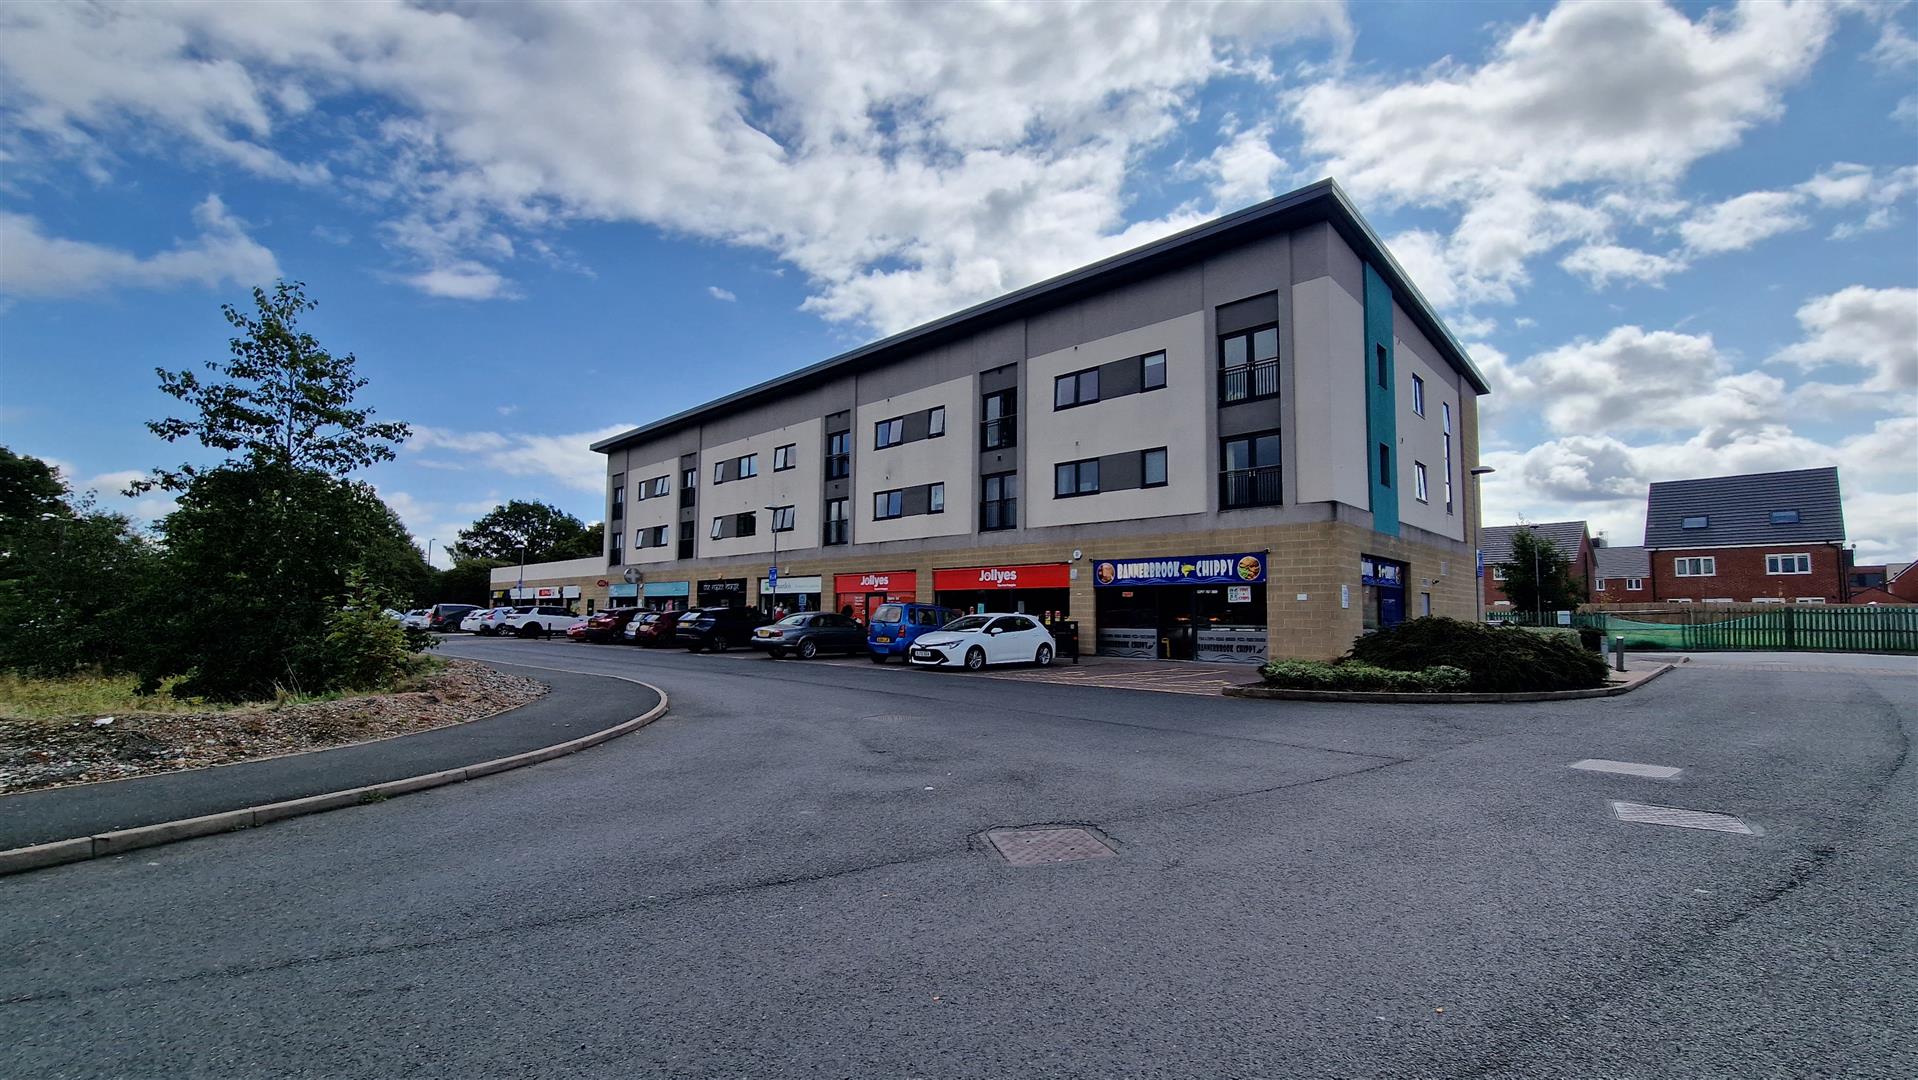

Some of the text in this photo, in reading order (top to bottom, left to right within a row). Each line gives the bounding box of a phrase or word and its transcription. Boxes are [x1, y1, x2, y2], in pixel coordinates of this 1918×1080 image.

[978, 568, 1017, 583] Jollyes
[1117, 559, 1234, 579] BANNERBROOK CHIPPY
[860, 574, 889, 587] Jollyes
